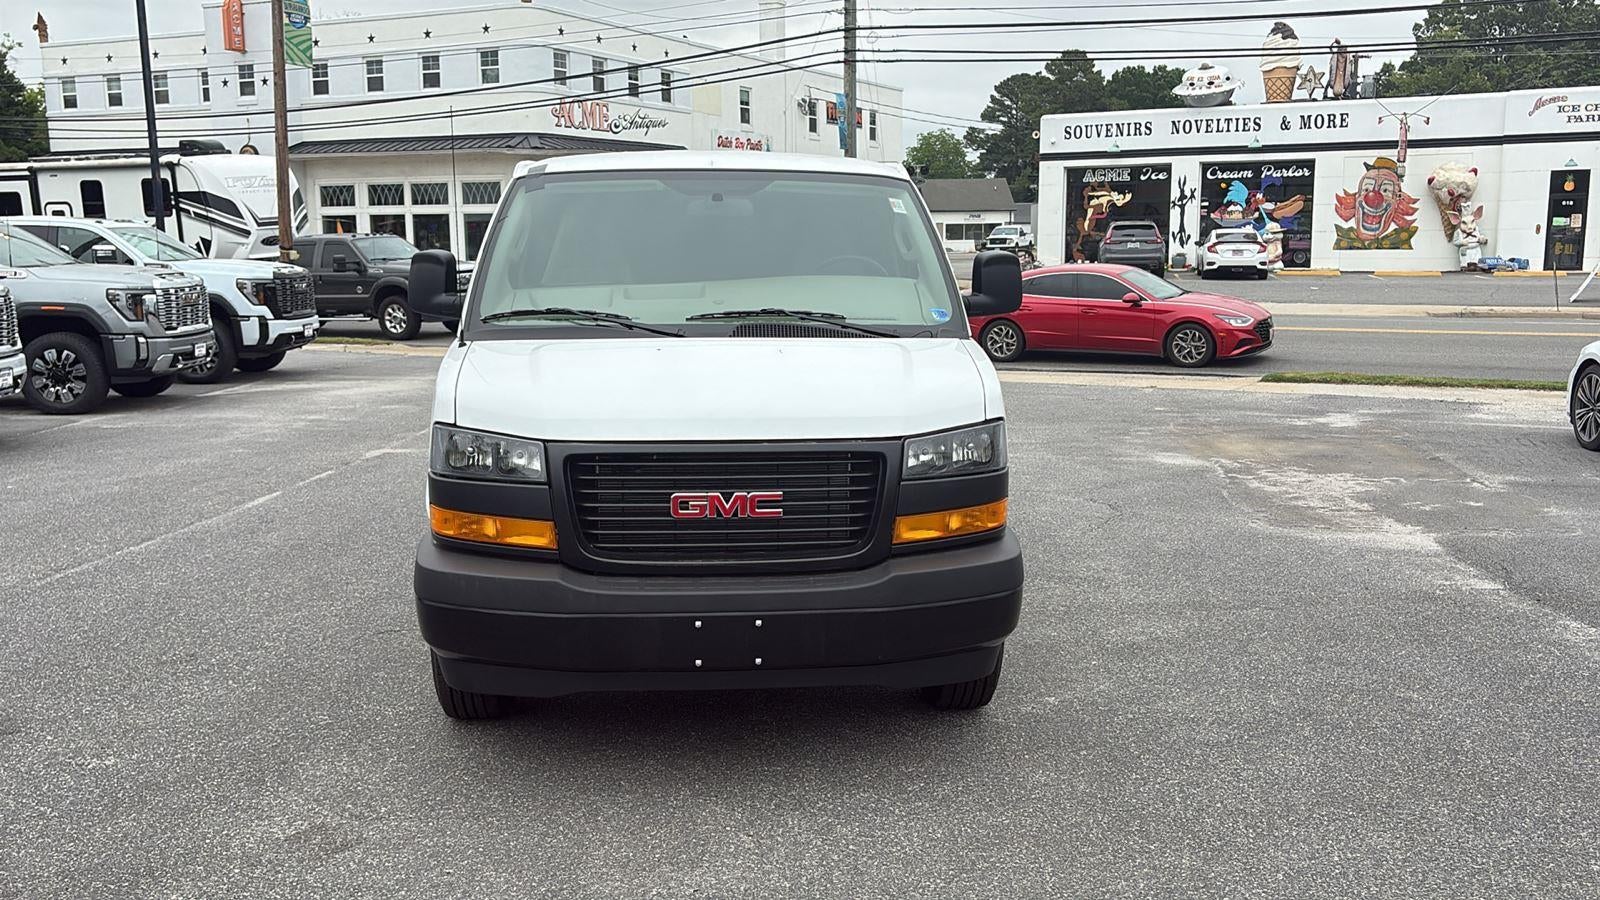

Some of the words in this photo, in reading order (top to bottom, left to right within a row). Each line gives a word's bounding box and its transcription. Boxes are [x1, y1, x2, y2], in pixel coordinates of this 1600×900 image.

[232, 2, 241, 47] ACME
[551, 98, 610, 132] ACME
[1528, 96, 1568, 117] Acme
[1557, 104, 1580, 113] ICE
[1064, 121, 1153, 140] SOUVENIRS
[1170, 116, 1262, 135] NOVELTIES
[1280, 115, 1292, 131] &
[1299, 112, 1350, 130] MORE
[717, 135, 733, 148] Dutch
[735, 137, 745, 150] Boy
[745, 138, 763, 151] Paints
[1082, 168, 1131, 182] ACME
[1139, 167, 1169, 181] Ice
[1206, 166, 1254, 179] Cream
[1261, 164, 1312, 178] Parlor
[670, 491, 784, 518] GMC
